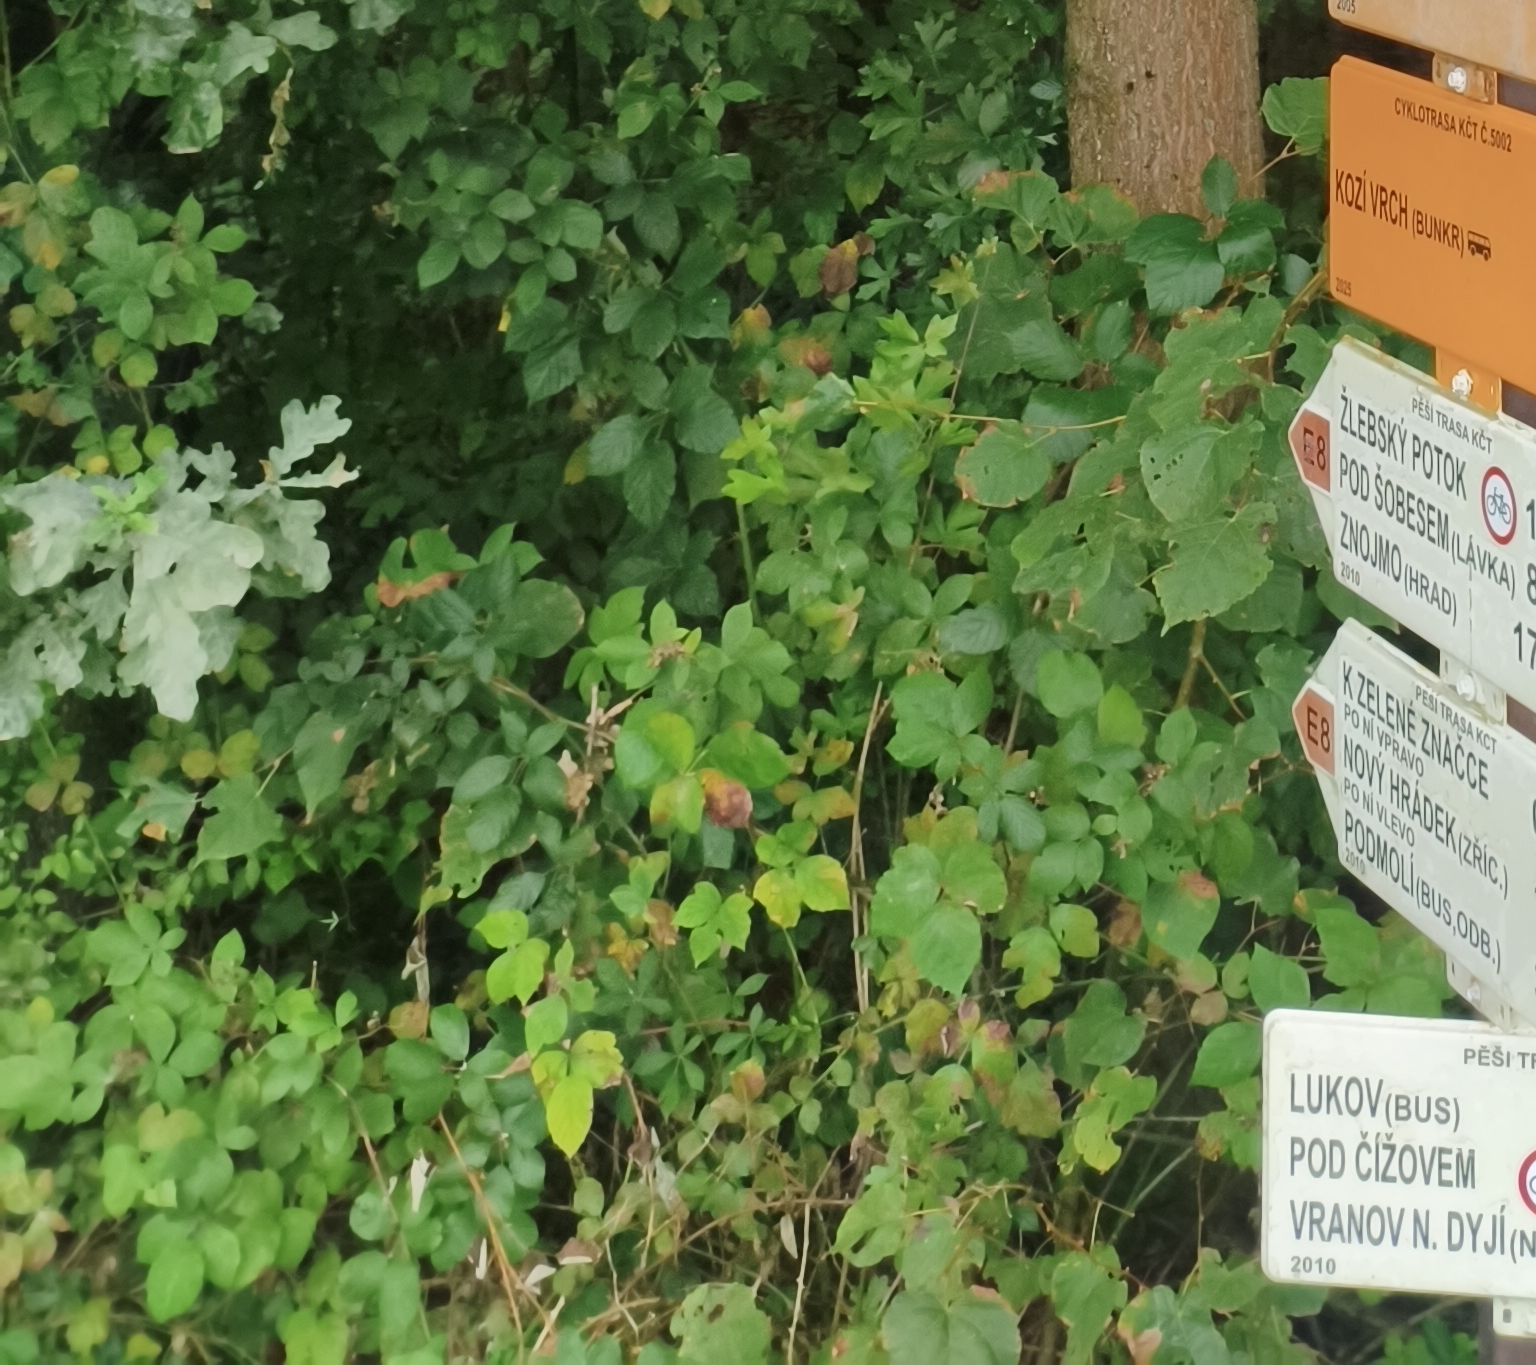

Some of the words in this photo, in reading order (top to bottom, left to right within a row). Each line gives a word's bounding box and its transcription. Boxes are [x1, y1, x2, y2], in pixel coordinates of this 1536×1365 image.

[1395, 97, 1456, 135] CYKLOTRASA
[1458, 115, 1478, 142] KČT
[1336, 169, 1366, 212] KOZÍ
[1370, 181, 1407, 230] VRCH
[1412, 208, 1463, 258] (BUNKR)
[1304, 428, 1326, 471] E8
[1340, 384, 1407, 464] ŽLEBSKÝ
[1413, 433, 1466, 501] POTOK
[1436, 410, 1469, 443] TRASA
[1472, 427, 1492, 454] KČT
[1340, 451, 1369, 502] POD
[1341, 561, 1360, 586] 2010
[1306, 704, 1331, 753] E8
[1343, 661, 1353, 700] K
[1358, 671, 1416, 747] ZELENÉ
[1421, 718, 1489, 800] ZNAČCE
[1344, 703, 1359, 729] PO
[1363, 714, 1373, 741] NÍ
[1377, 726, 1424, 777] VPRAVO
[1440, 701, 1473, 740] TRASA
[1344, 734, 1385, 795] NOVÝ
[1344, 777, 1359, 803] PO
[1363, 790, 1373, 816] NÍ
[1377, 801, 1415, 847] VLEVO
[1290, 1139, 1346, 1180] POD
[1354, 1130, 1476, 1190] ČÍŽOVEM
[1290, 1200, 1403, 1245] VRANOV
[1412, 1209, 1437, 1250] N.
[1290, 1256, 1336, 1275] 2010
